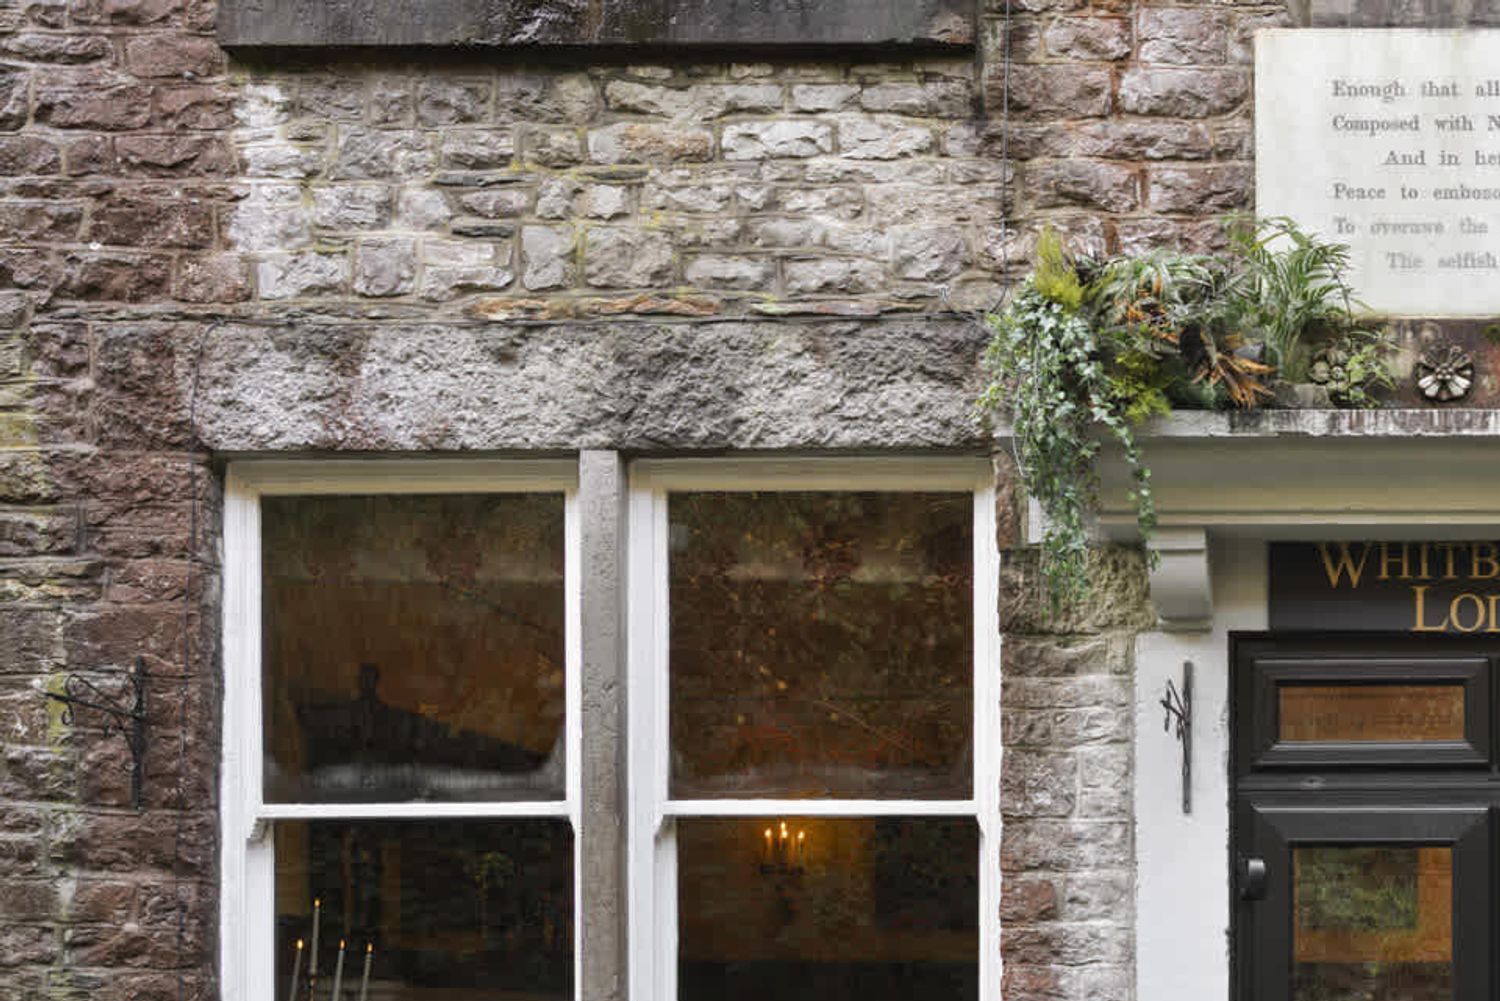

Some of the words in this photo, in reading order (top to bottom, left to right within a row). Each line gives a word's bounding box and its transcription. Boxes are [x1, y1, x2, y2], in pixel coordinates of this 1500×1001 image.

[1332, 80, 1406, 102] Enough
[1421, 80, 1461, 98] that
[1475, 80, 1500, 98] all
[1332, 115, 1419, 136] Composed
[1434, 115, 1474, 132] with
[1381, 150, 1426, 166] And
[1438, 150, 1461, 166] in
[1333, 182, 1386, 200] Peace
[1400, 184, 1418, 200] to
[1333, 217, 1356, 234] To
[1460, 217, 1488, 234] the
[1386, 251, 1424, 269] The
[1438, 251, 1498, 269] selfish
